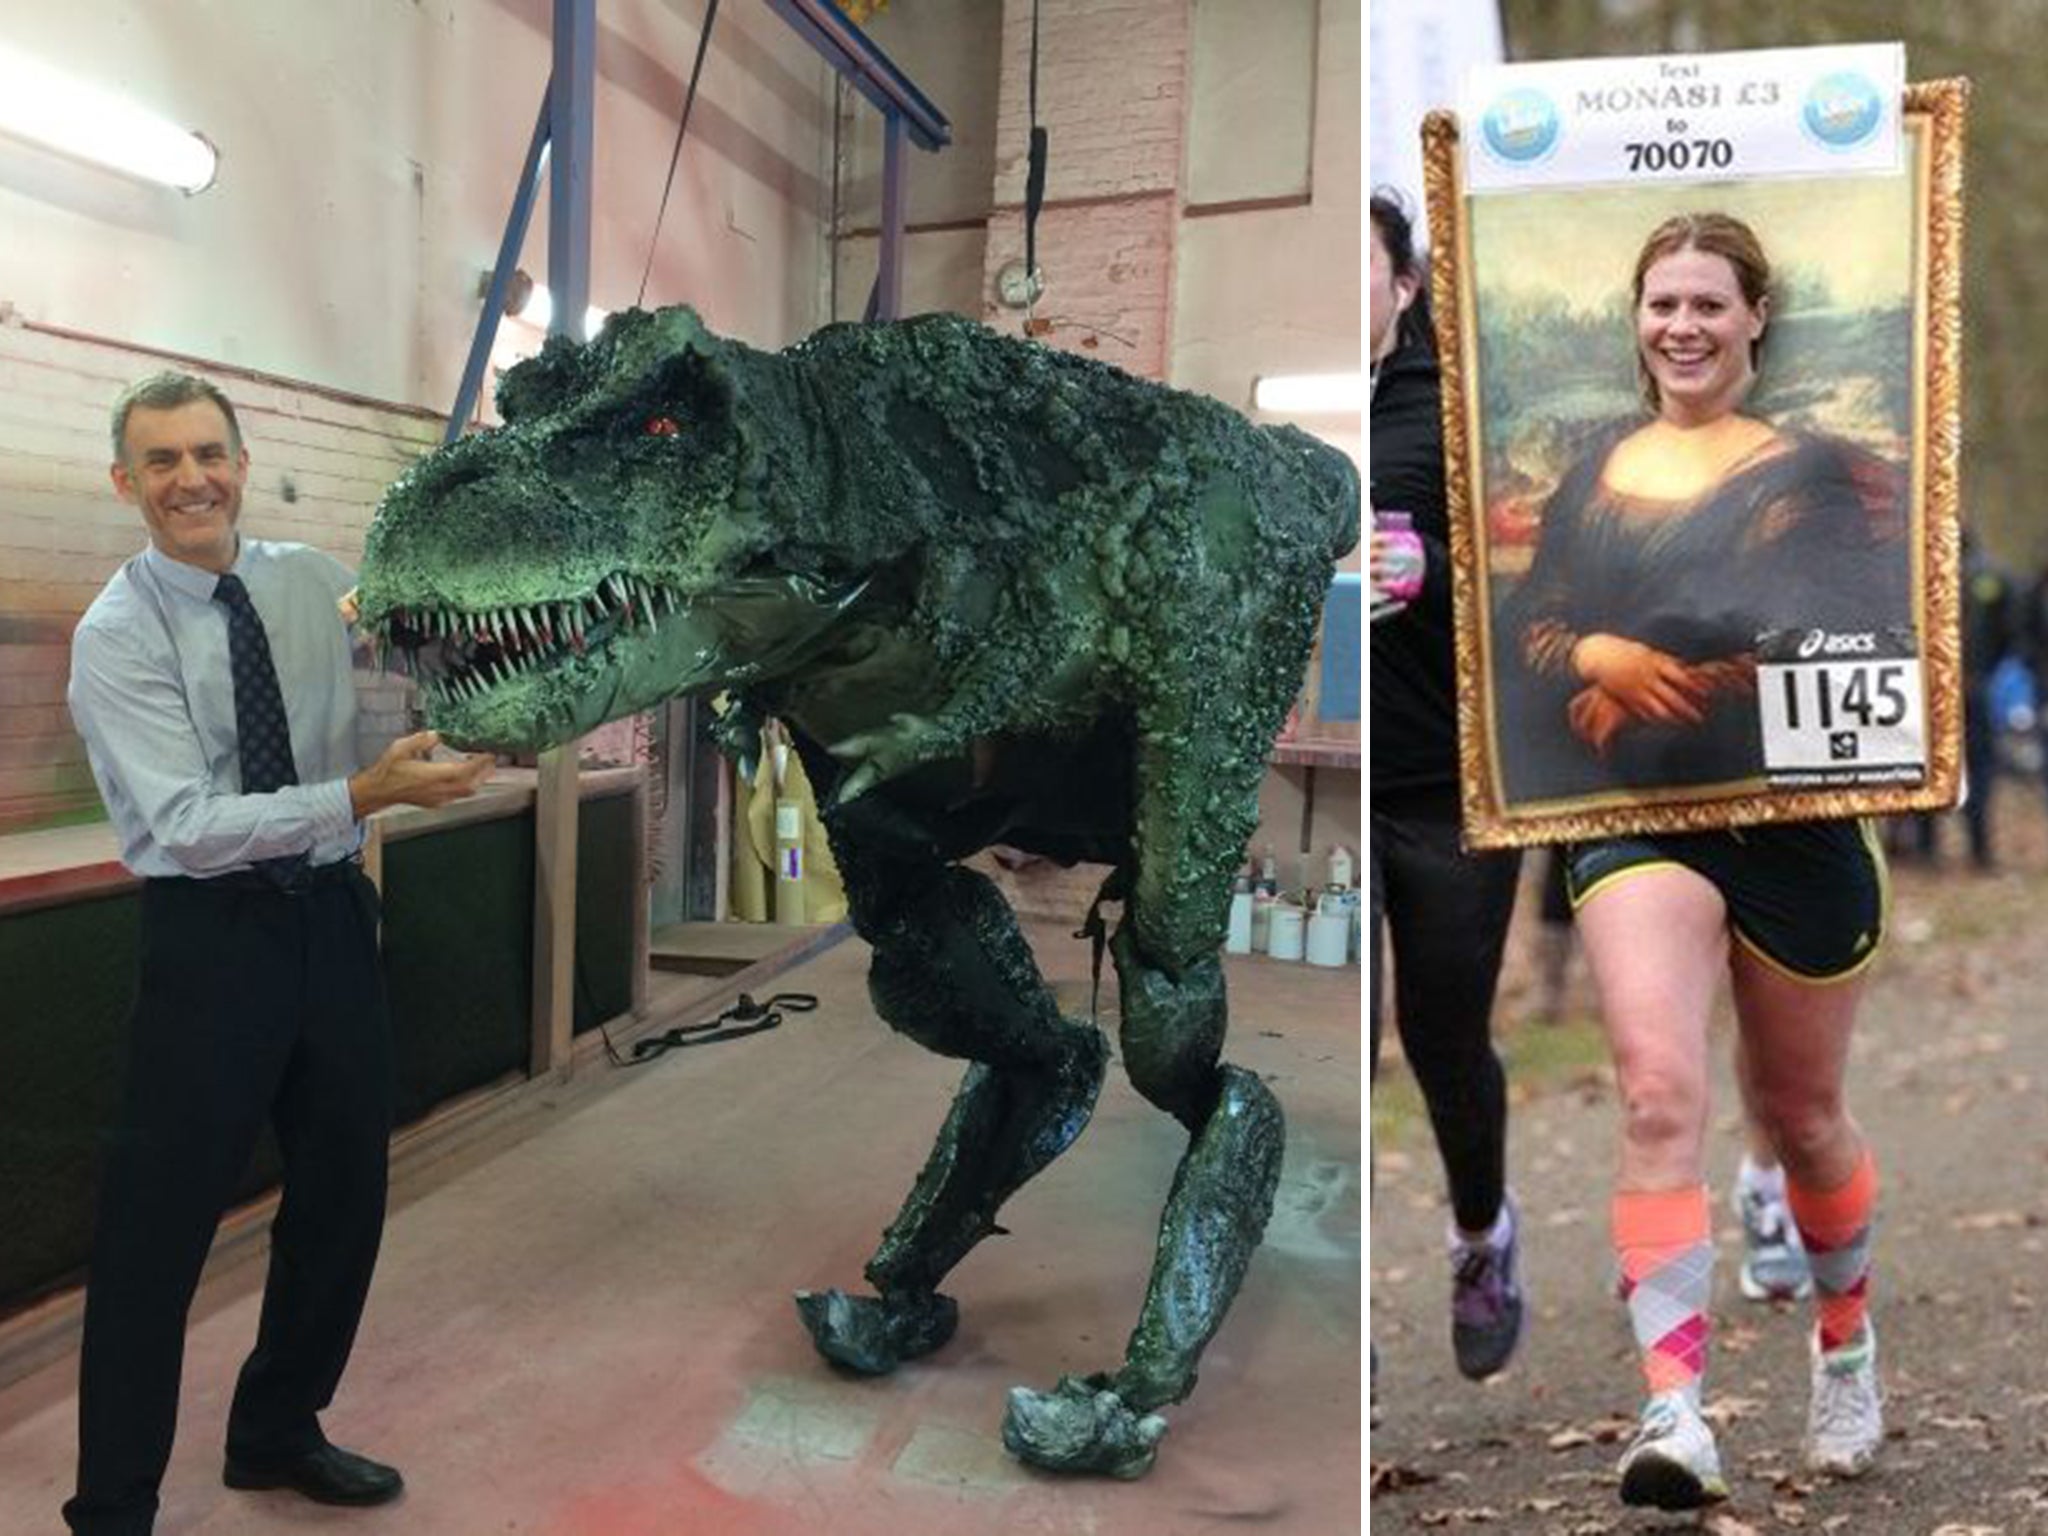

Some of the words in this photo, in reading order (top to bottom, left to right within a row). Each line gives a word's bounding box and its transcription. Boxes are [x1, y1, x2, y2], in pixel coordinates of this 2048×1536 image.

[1659, 62, 1700, 79] Text
[1577, 83, 1721, 114] MONA81
[1736, 82, 1781, 106] £3
[1666, 117, 1689, 134] to
[1624, 138, 1734, 172] 70070
[1783, 665, 1908, 730] 1145
